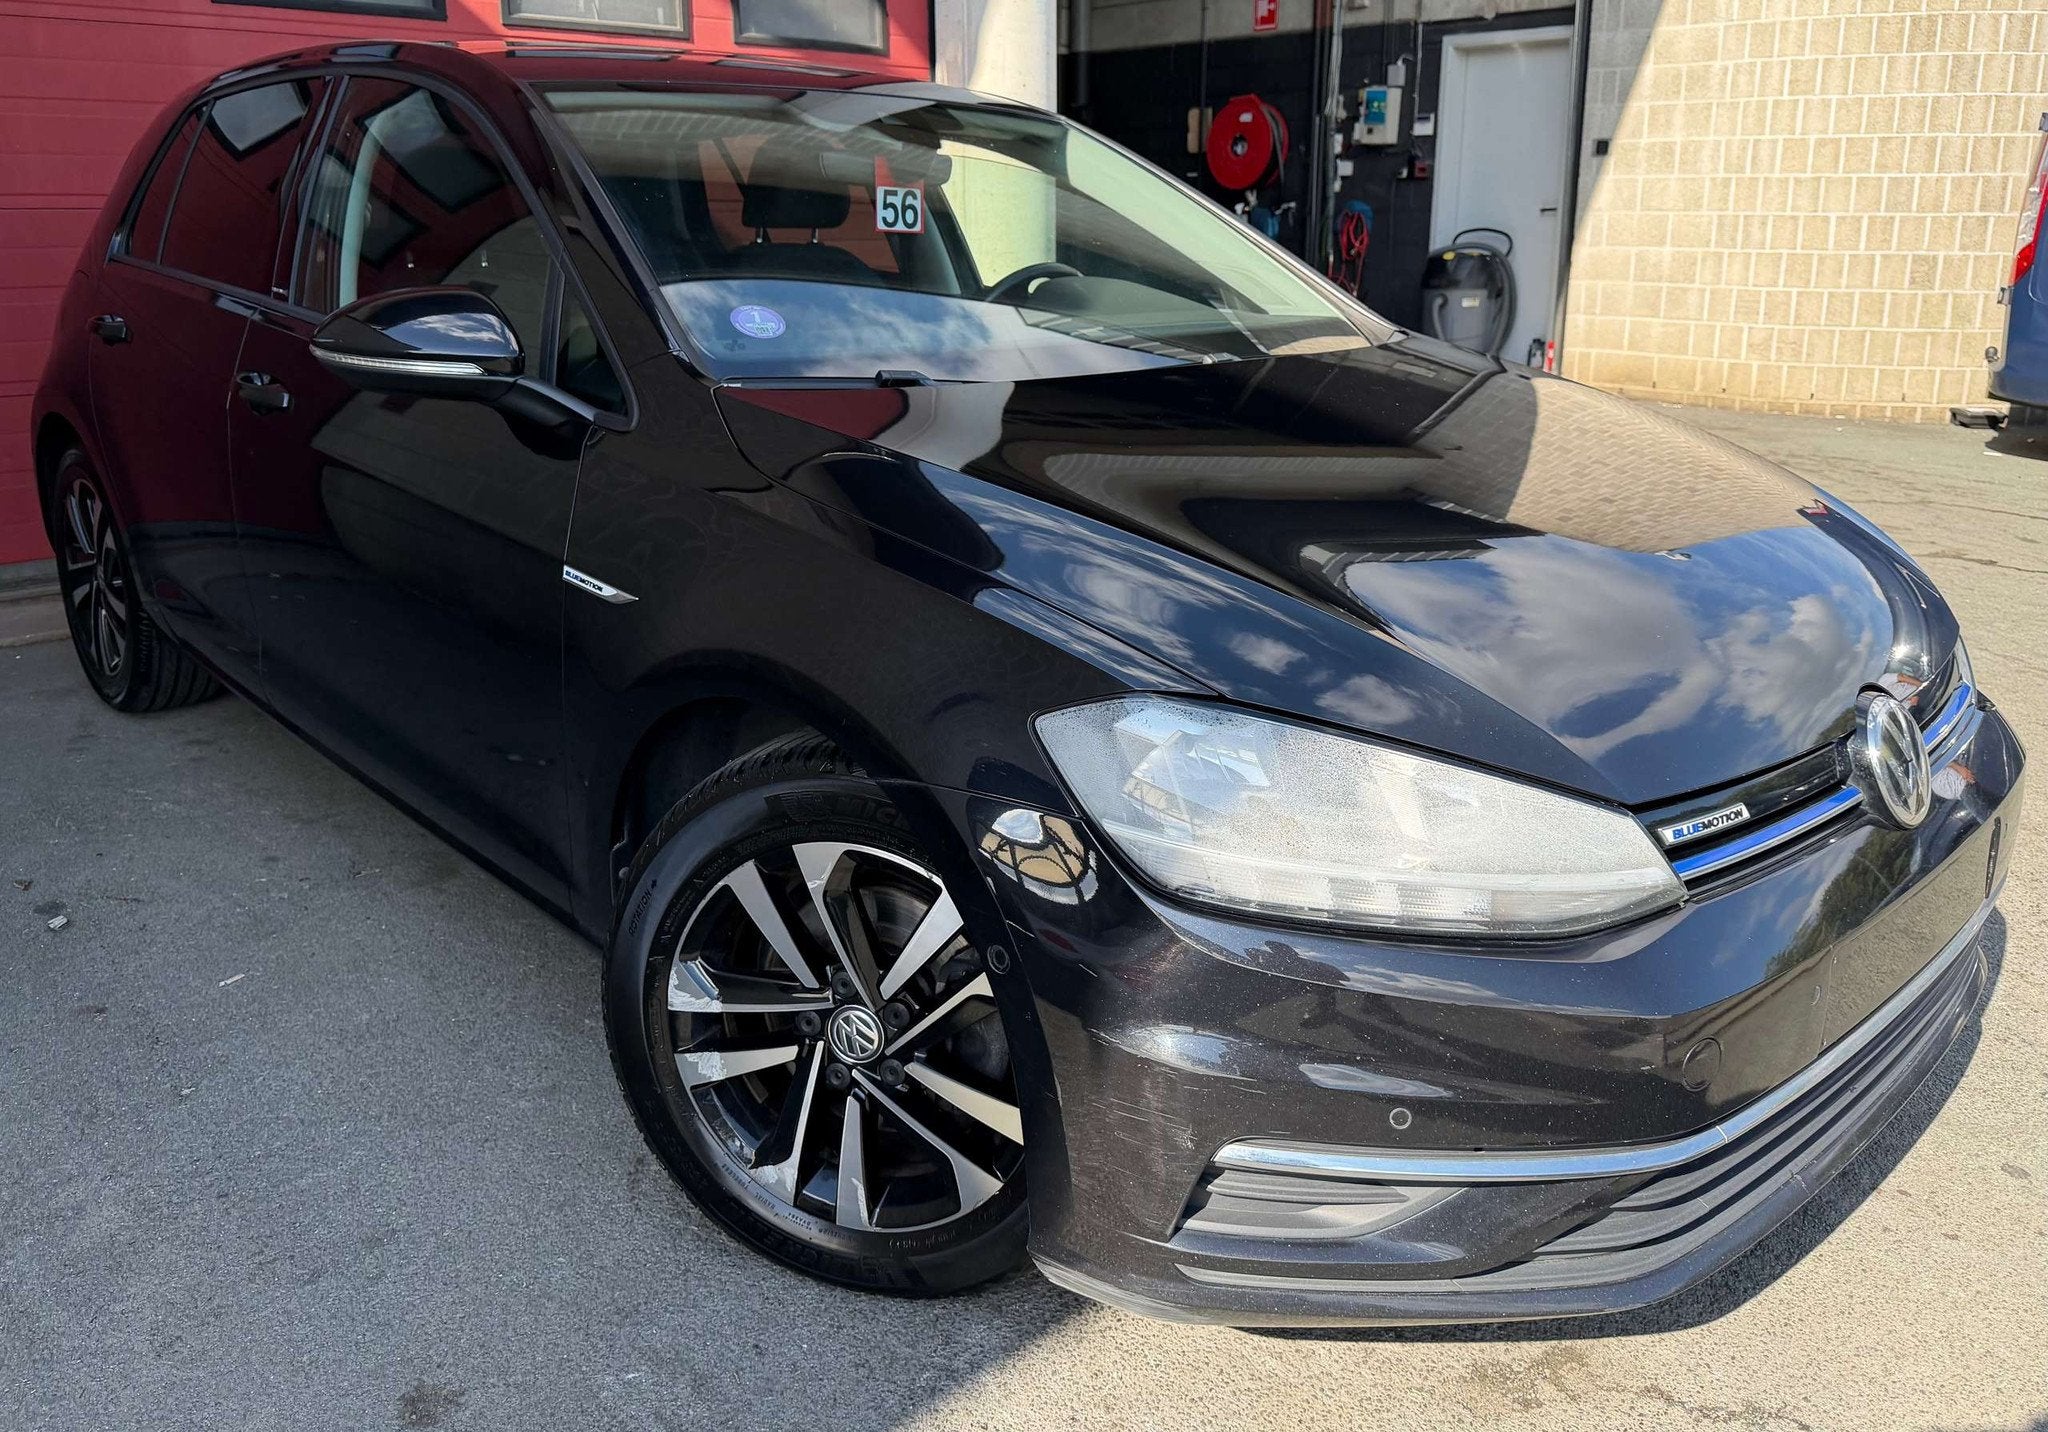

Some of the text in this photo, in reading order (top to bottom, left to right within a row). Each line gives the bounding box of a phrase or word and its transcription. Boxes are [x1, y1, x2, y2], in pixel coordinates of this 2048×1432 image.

[881, 189, 919, 230] 56
[564, 569, 604, 593] BLUEMOTION
[1672, 808, 1744, 840] BLUEMOTION
[628, 888, 652, 937] ROTATION
